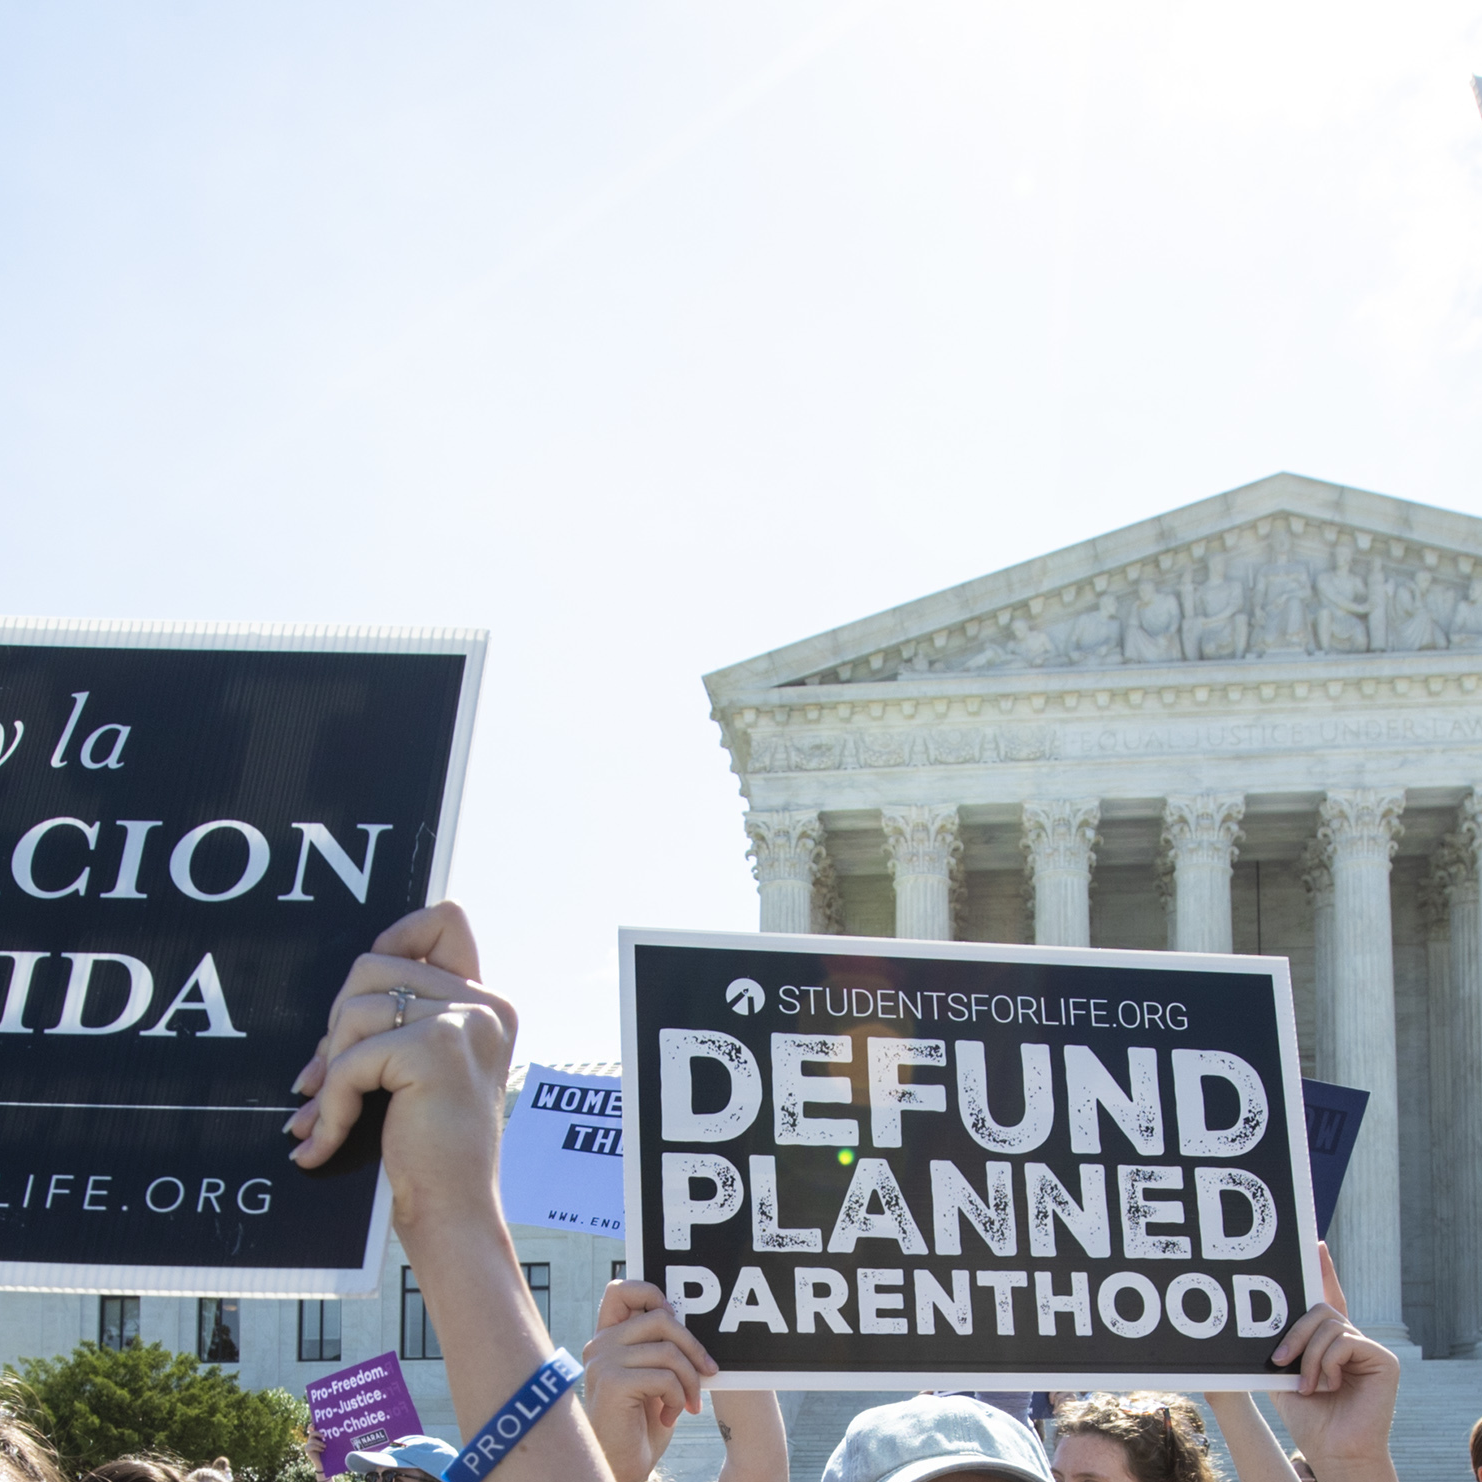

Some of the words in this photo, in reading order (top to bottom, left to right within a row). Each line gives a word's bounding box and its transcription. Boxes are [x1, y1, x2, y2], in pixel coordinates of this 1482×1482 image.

[49, 690, 133, 770] la
[1319, 718, 1416, 742] UNDER
[777, 985, 1189, 1031] STUDENTSFORLIFE.ORG
[658, 1027, 1270, 1158] DEFUND
[574, 1126, 623, 1155] TH
[660, 1151, 1279, 1261] PLANNED
[664, 1264, 1289, 1340] PARENTHOOD
[310, 1366, 389, 1404] Pro-Freedom.
[314, 1389, 387, 1423] Pro-Justice.
[319, 1409, 391, 1442] Pro-Choice.
[361, 1431, 385, 1444] NARAL
